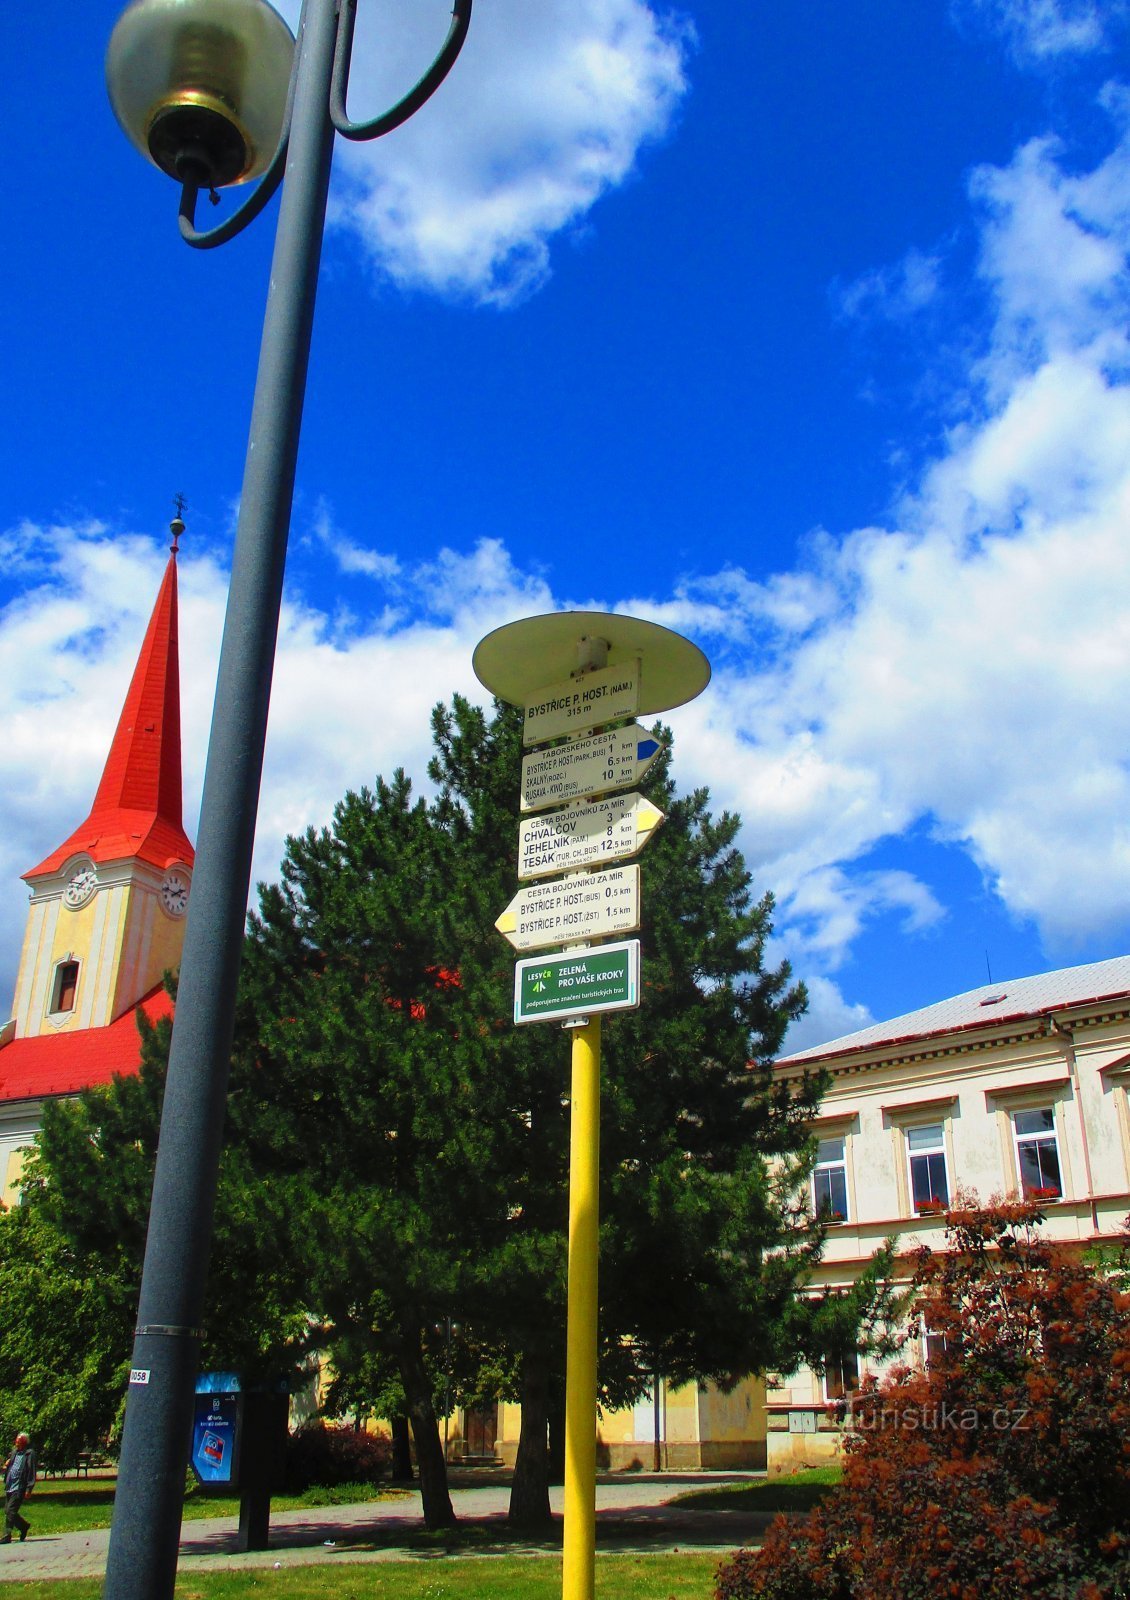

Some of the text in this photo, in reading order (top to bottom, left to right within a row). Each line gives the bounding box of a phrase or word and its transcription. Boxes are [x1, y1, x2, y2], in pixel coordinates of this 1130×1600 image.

[528, 697, 571, 718] BYSTŘICE
[573, 694, 580, 705] P.
[582, 686, 608, 702] HOST.
[567, 704, 592, 717] 315 m
[592, 734, 616, 746] CESTA
[608, 744, 613, 752] 1
[602, 770, 614, 780] 10
[530, 799, 625, 829] CESTA BOJOVNÍKŮ ZA MÍR
[524, 821, 576, 842] CHVALČOV
[606, 812, 613, 822] 3
[524, 836, 570, 856] JEHELNÍK
[606, 826, 613, 836] 8
[523, 852, 554, 868] TESÁK
[528, 871, 623, 898] CESTA BOJOVNÍKŮ ZA MÍR
[520, 898, 554, 915] BYSTŘICE
[556, 898, 562, 908] P.
[520, 916, 554, 934] BYSTŘICE
[555, 916, 562, 926] P.
[558, 962, 587, 977] ZELENÁ
[558, 969, 624, 988] PRO VAŠE KROKY
[526, 998, 560, 1009] podporujeme
[561, 993, 580, 1002] značení
[582, 989, 612, 999] turistických
